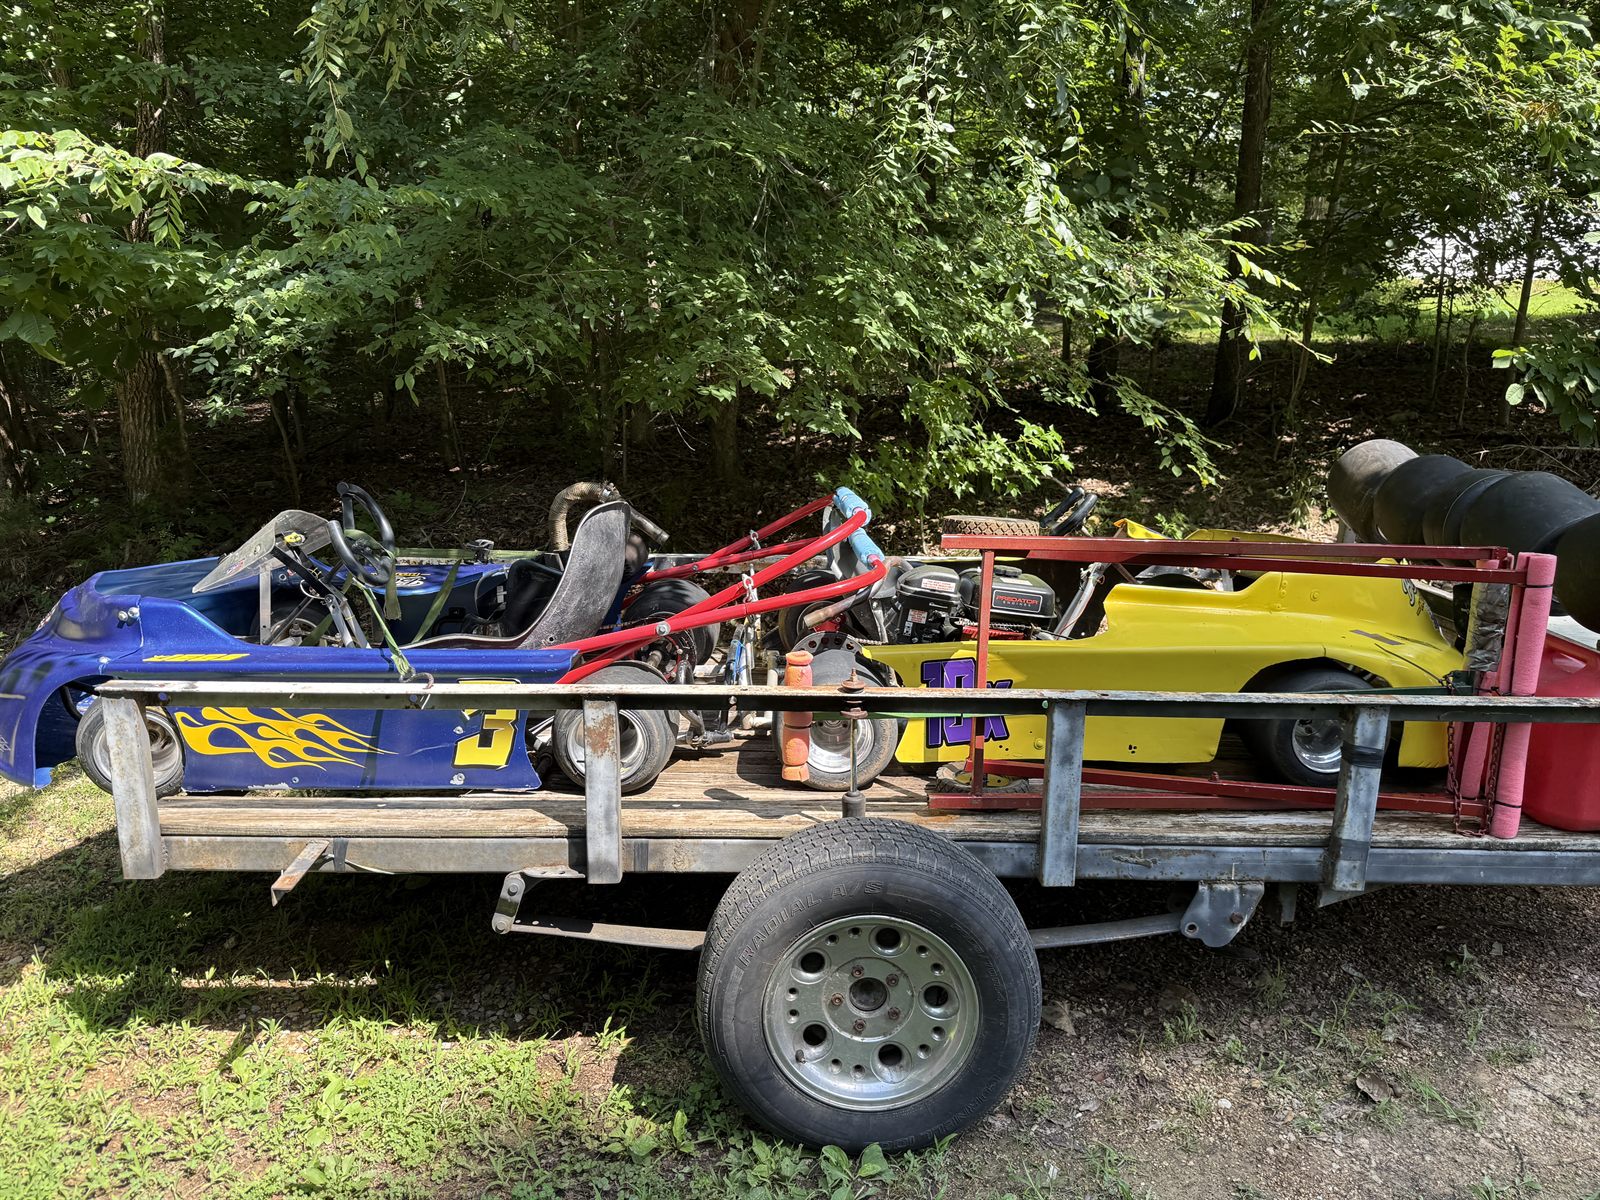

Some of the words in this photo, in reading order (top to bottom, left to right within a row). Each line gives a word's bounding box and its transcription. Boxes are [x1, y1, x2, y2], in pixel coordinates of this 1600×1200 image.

[995, 595, 1040, 605] PREDATOR
[452, 678, 521, 770] 3
[737, 893, 821, 967] RADIAL
[832, 880, 884, 897] A/S
